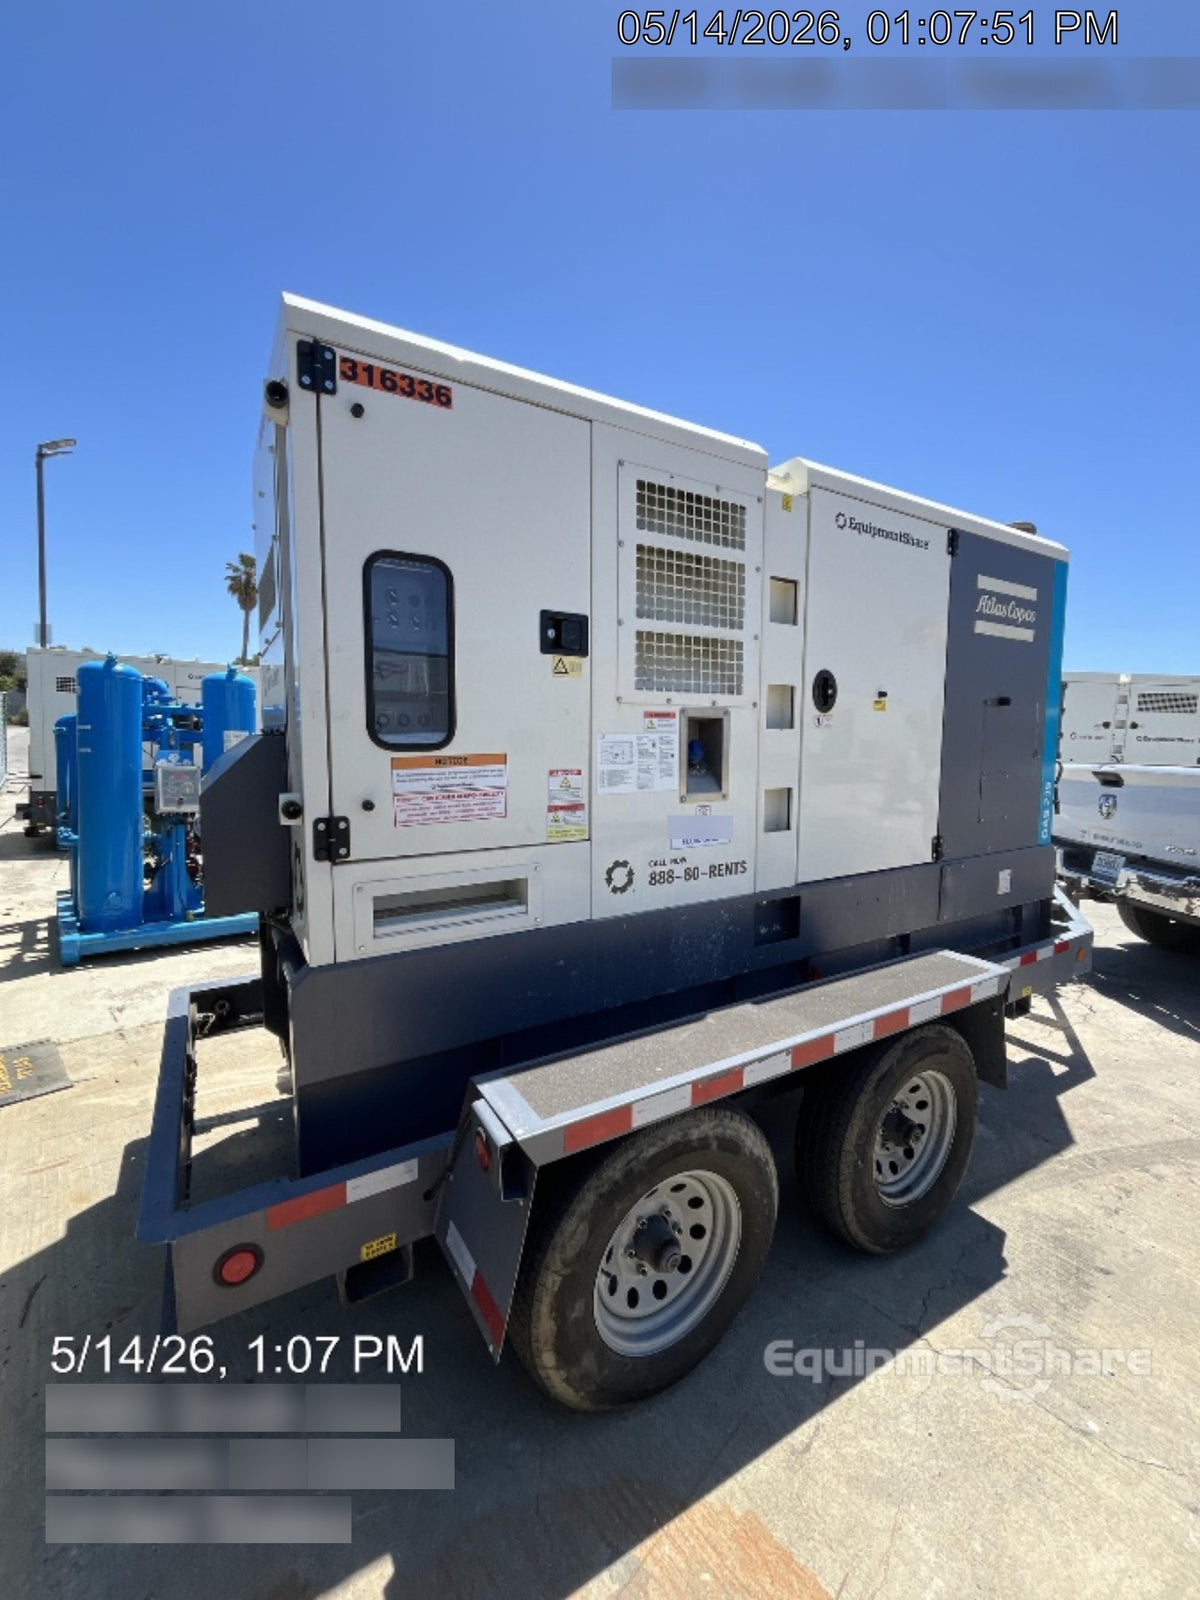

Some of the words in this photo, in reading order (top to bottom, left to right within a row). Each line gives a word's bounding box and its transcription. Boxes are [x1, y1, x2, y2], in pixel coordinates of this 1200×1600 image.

[340, 356, 452, 408] 316336
[976, 595, 1007, 618] Atlas
[648, 860, 748, 887] 888-80-RENTS
